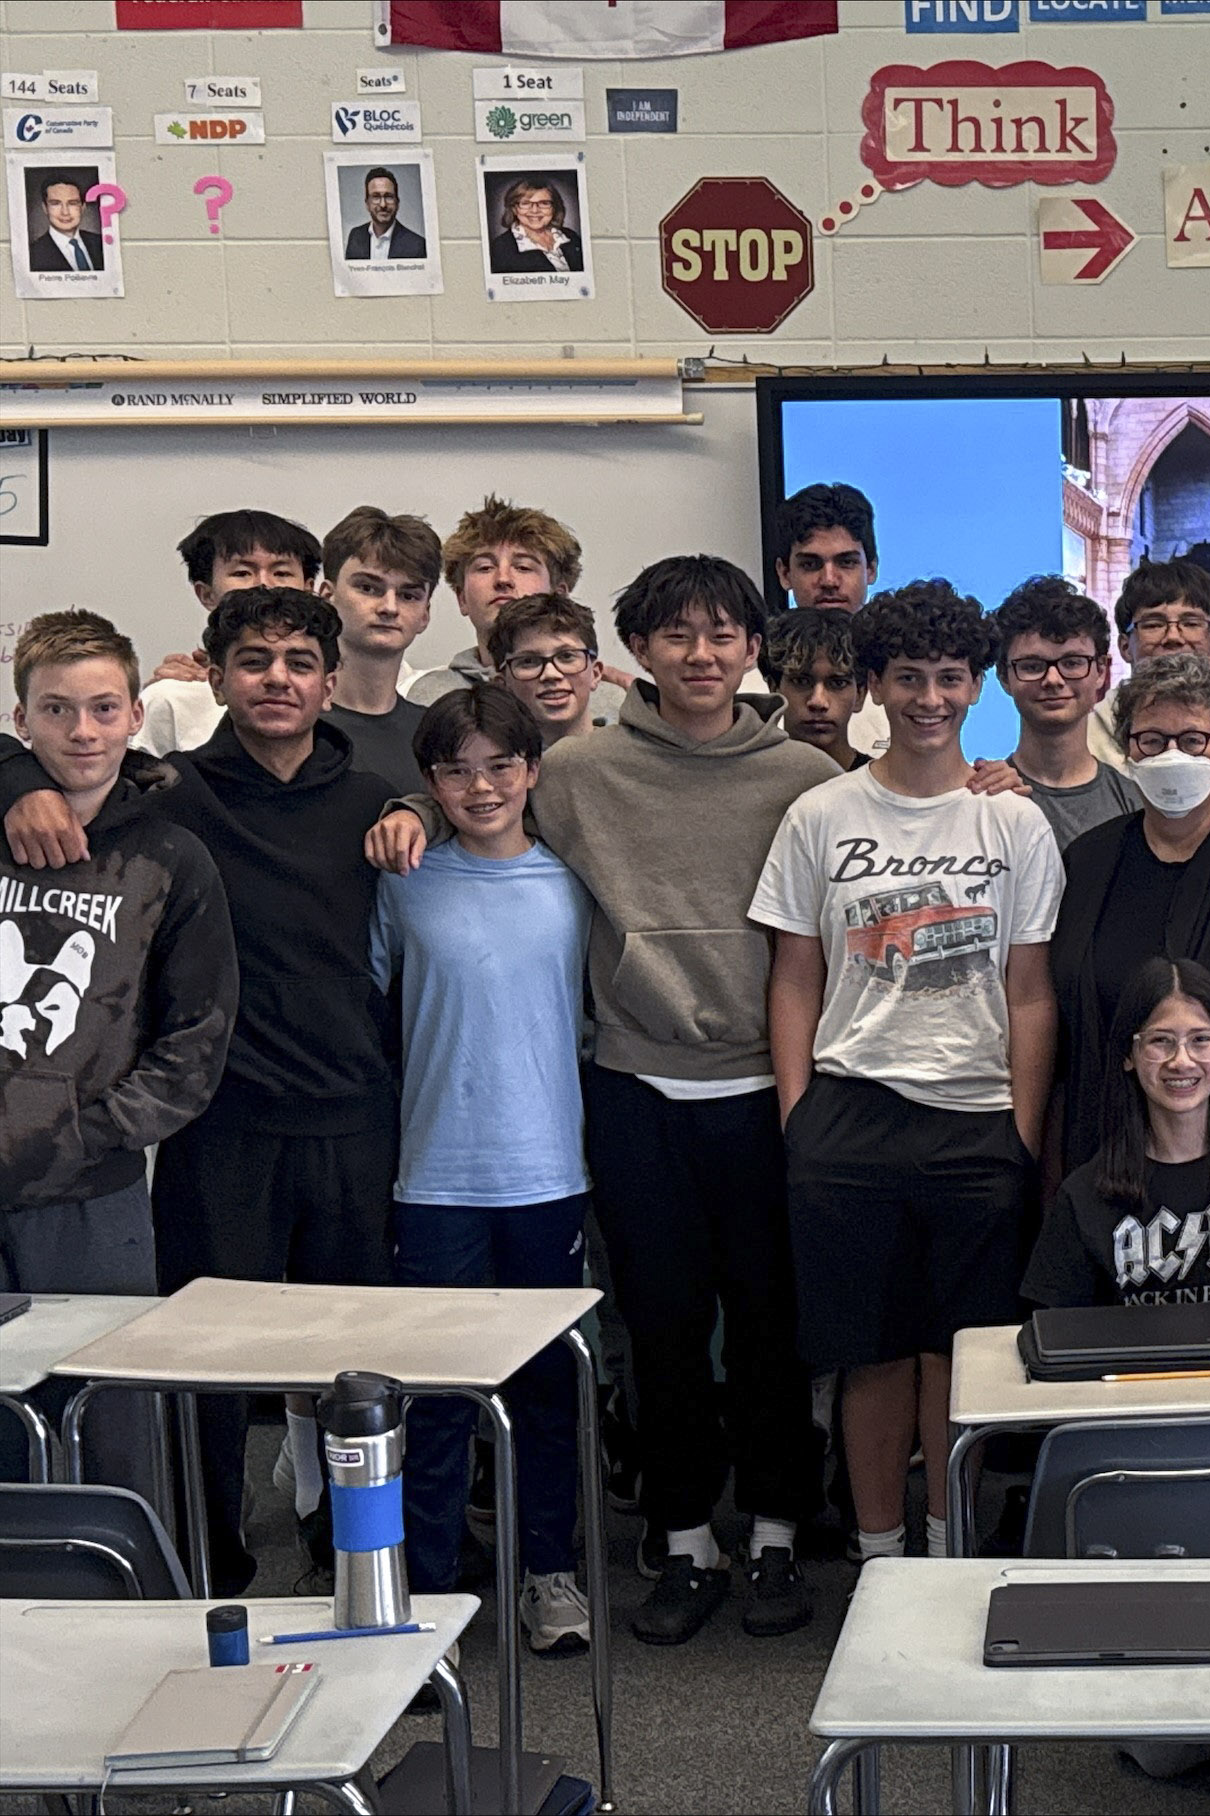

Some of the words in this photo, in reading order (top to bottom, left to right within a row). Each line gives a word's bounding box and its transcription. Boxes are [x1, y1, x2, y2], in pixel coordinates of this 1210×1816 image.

[911, 0, 1012, 23] FIND
[8, 80, 37, 95] 144
[48, 79, 88, 95] Seats
[187, 84, 197, 99] 7
[207, 83, 248, 98] Seats
[503, 75, 512, 88] 1
[517, 75, 553, 89] Seat
[363, 109, 401, 122] BLOC
[519, 112, 573, 131] green
[189, 119, 248, 140] NDP
[893, 96, 1094, 155] Think
[671, 228, 804, 283] STOP
[502, 275, 544, 286] Elizabeth
[547, 275, 571, 287] May
[127, 394, 167, 406] RAND
[261, 393, 353, 405] SIMPLIFIED
[358, 392, 417, 405] WORLD
[828, 837, 1011, 884] Bronco
[1176, 1286, 1199, 1305] IN
